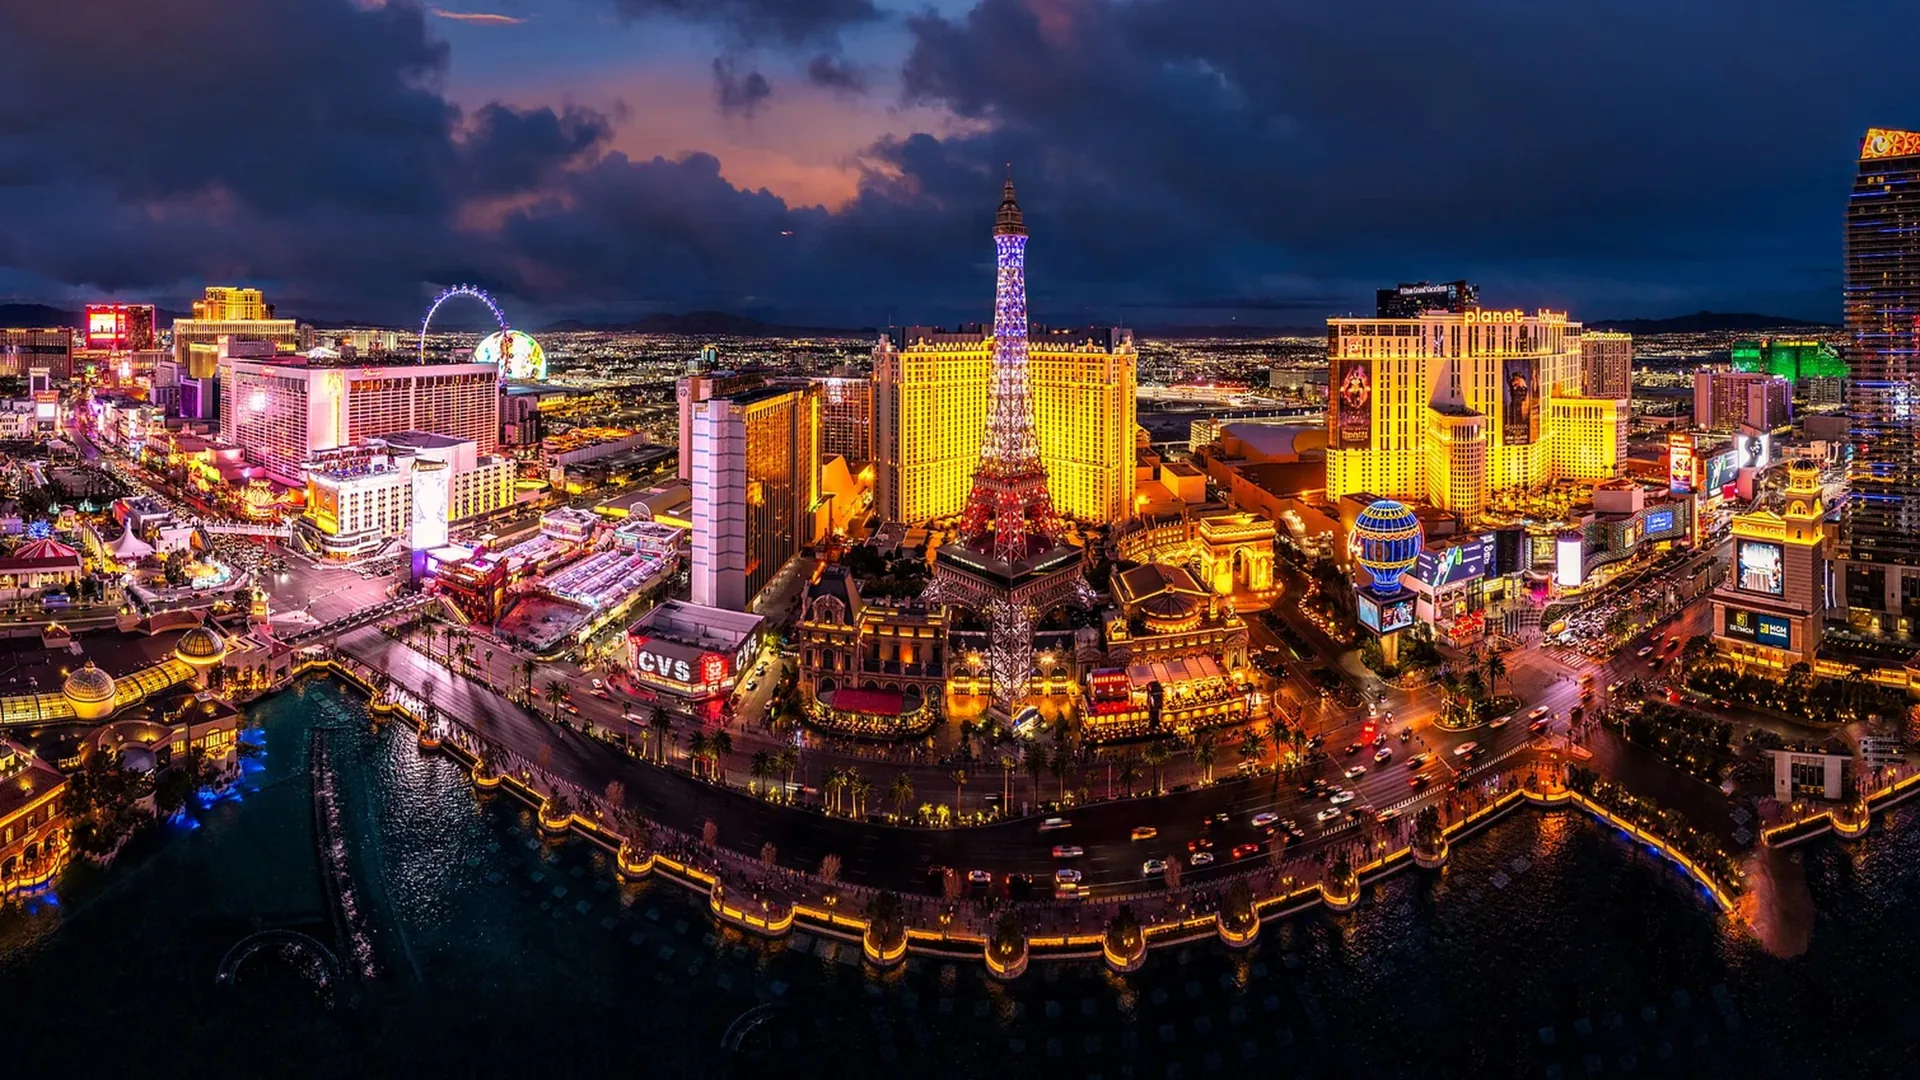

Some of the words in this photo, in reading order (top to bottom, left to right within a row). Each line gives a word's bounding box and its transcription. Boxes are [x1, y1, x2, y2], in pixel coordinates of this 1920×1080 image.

[1464, 306, 1524, 327] planet
[1538, 307, 1567, 328] hollywood
[638, 650, 691, 682] CVS
[735, 633, 757, 671] CVS
